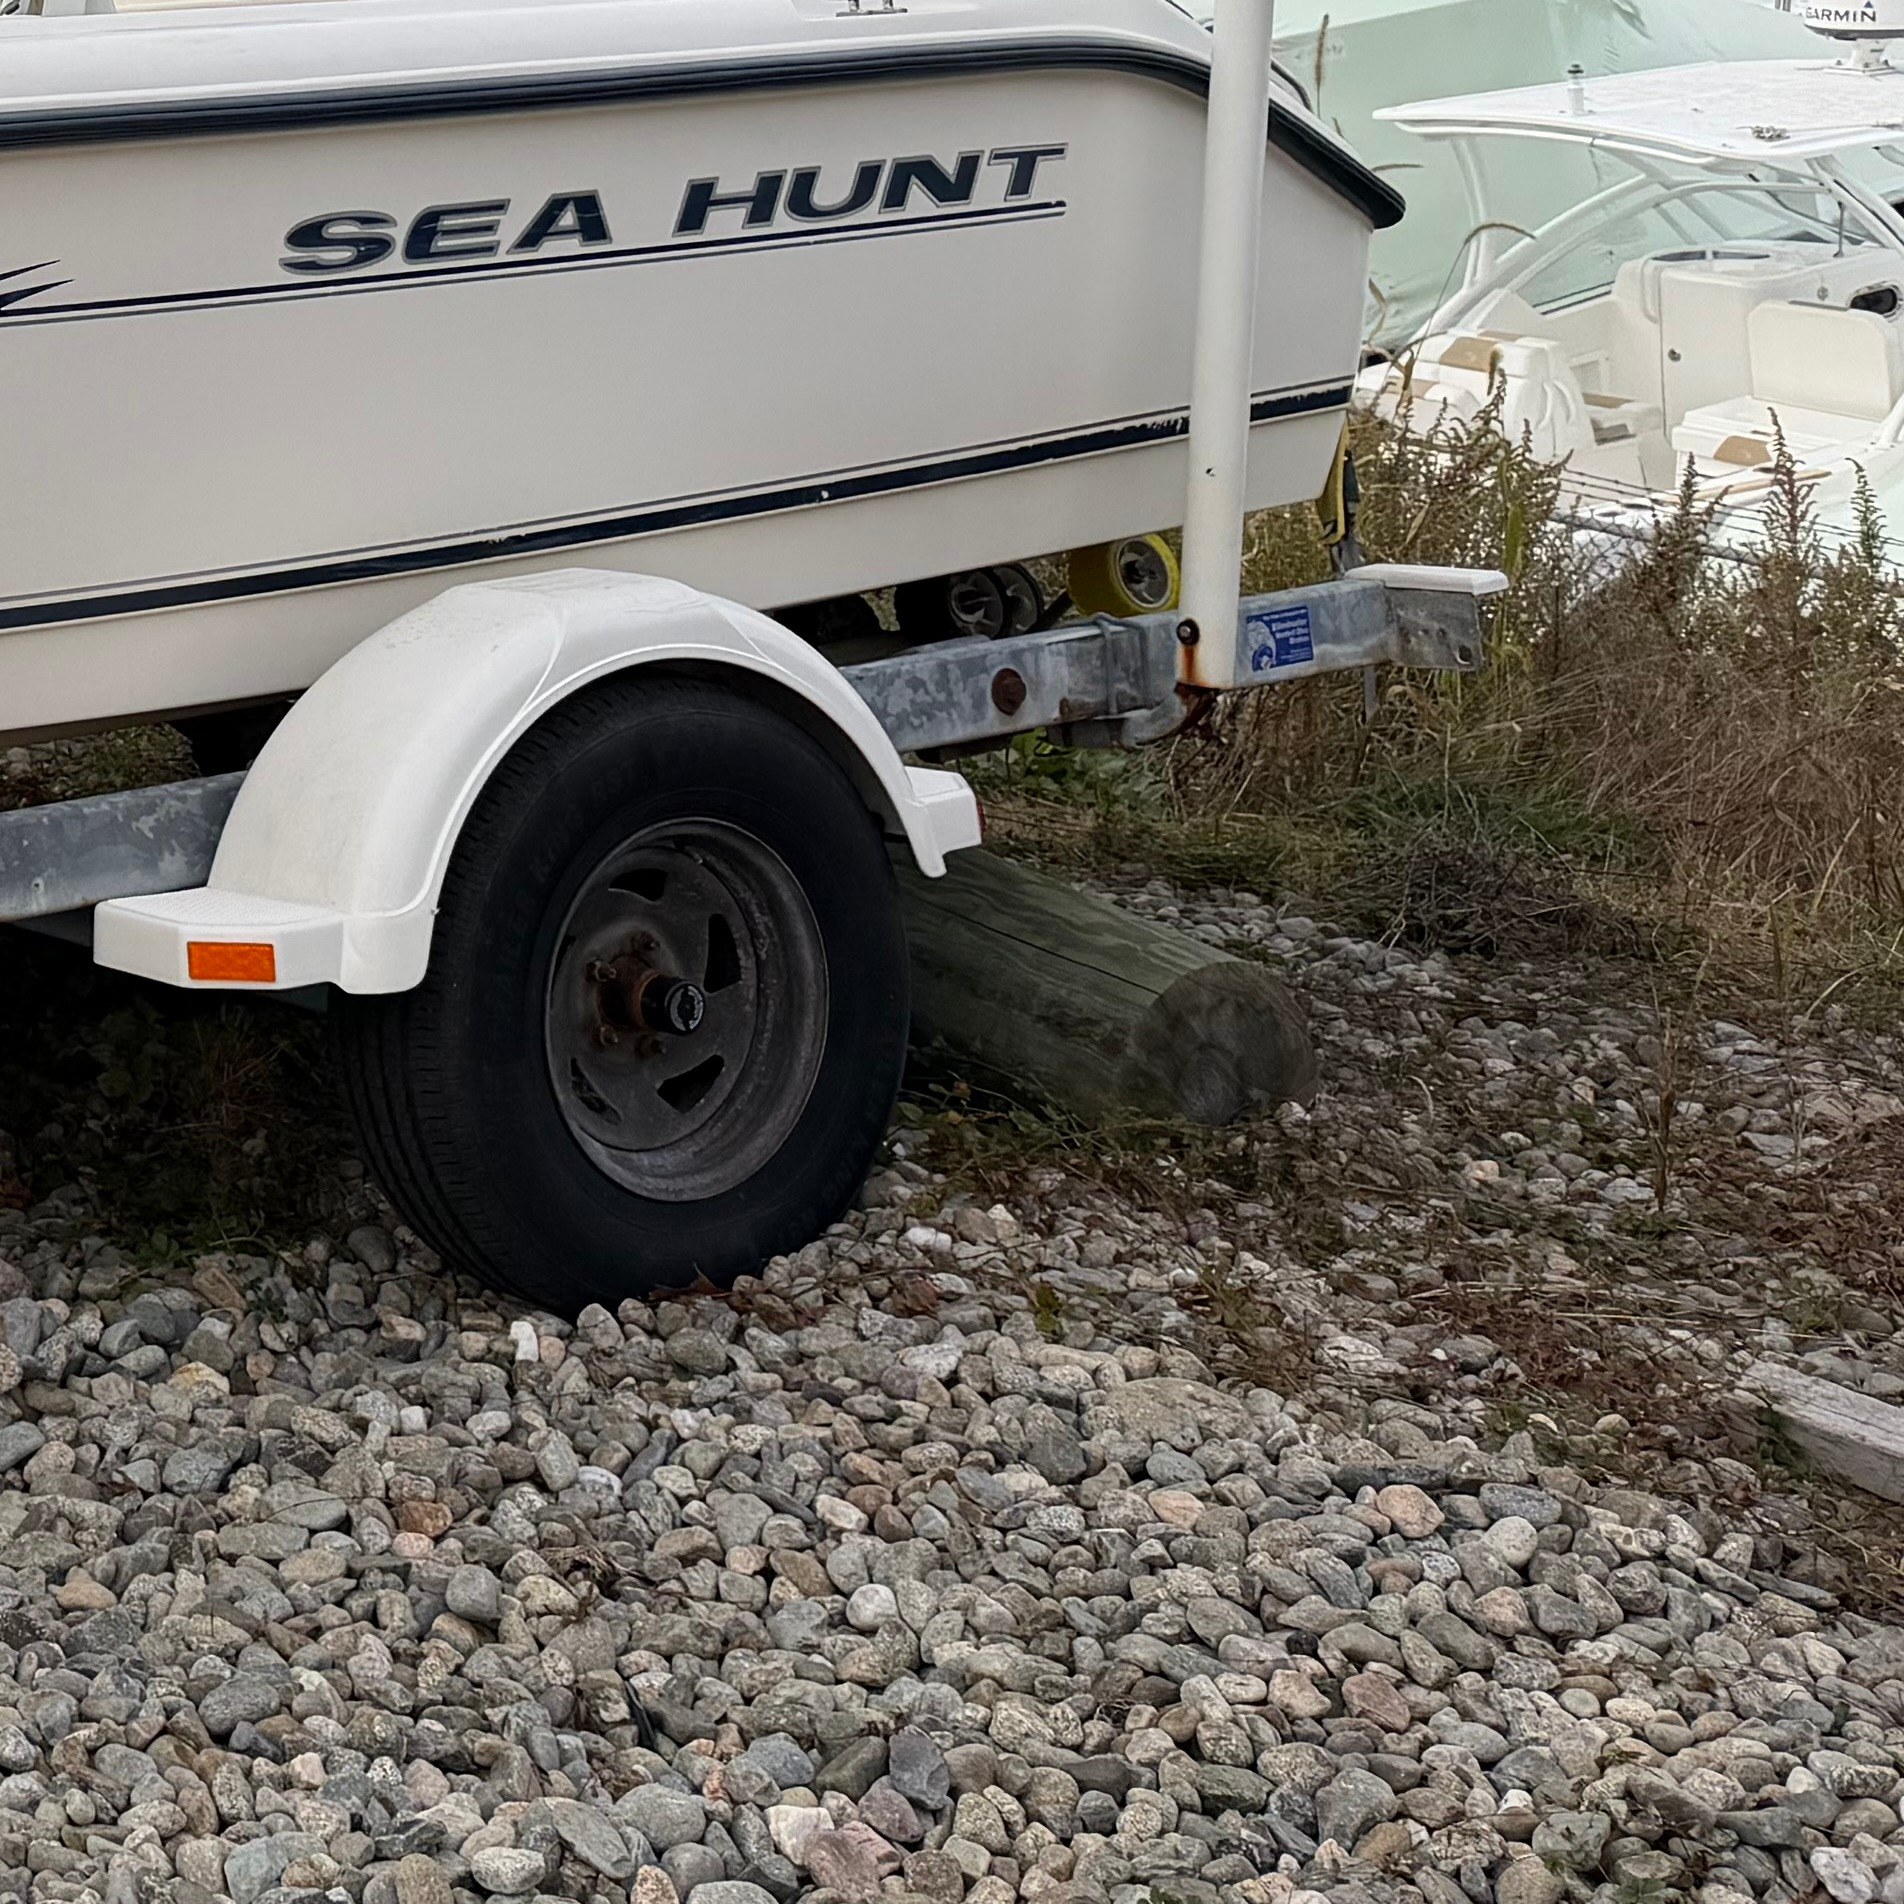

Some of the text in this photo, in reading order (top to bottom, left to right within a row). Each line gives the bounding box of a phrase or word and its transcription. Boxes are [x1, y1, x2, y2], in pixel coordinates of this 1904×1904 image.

[1805, 6, 1877, 23] GARMIN
[278, 142, 1070, 277] SEA HUNT
